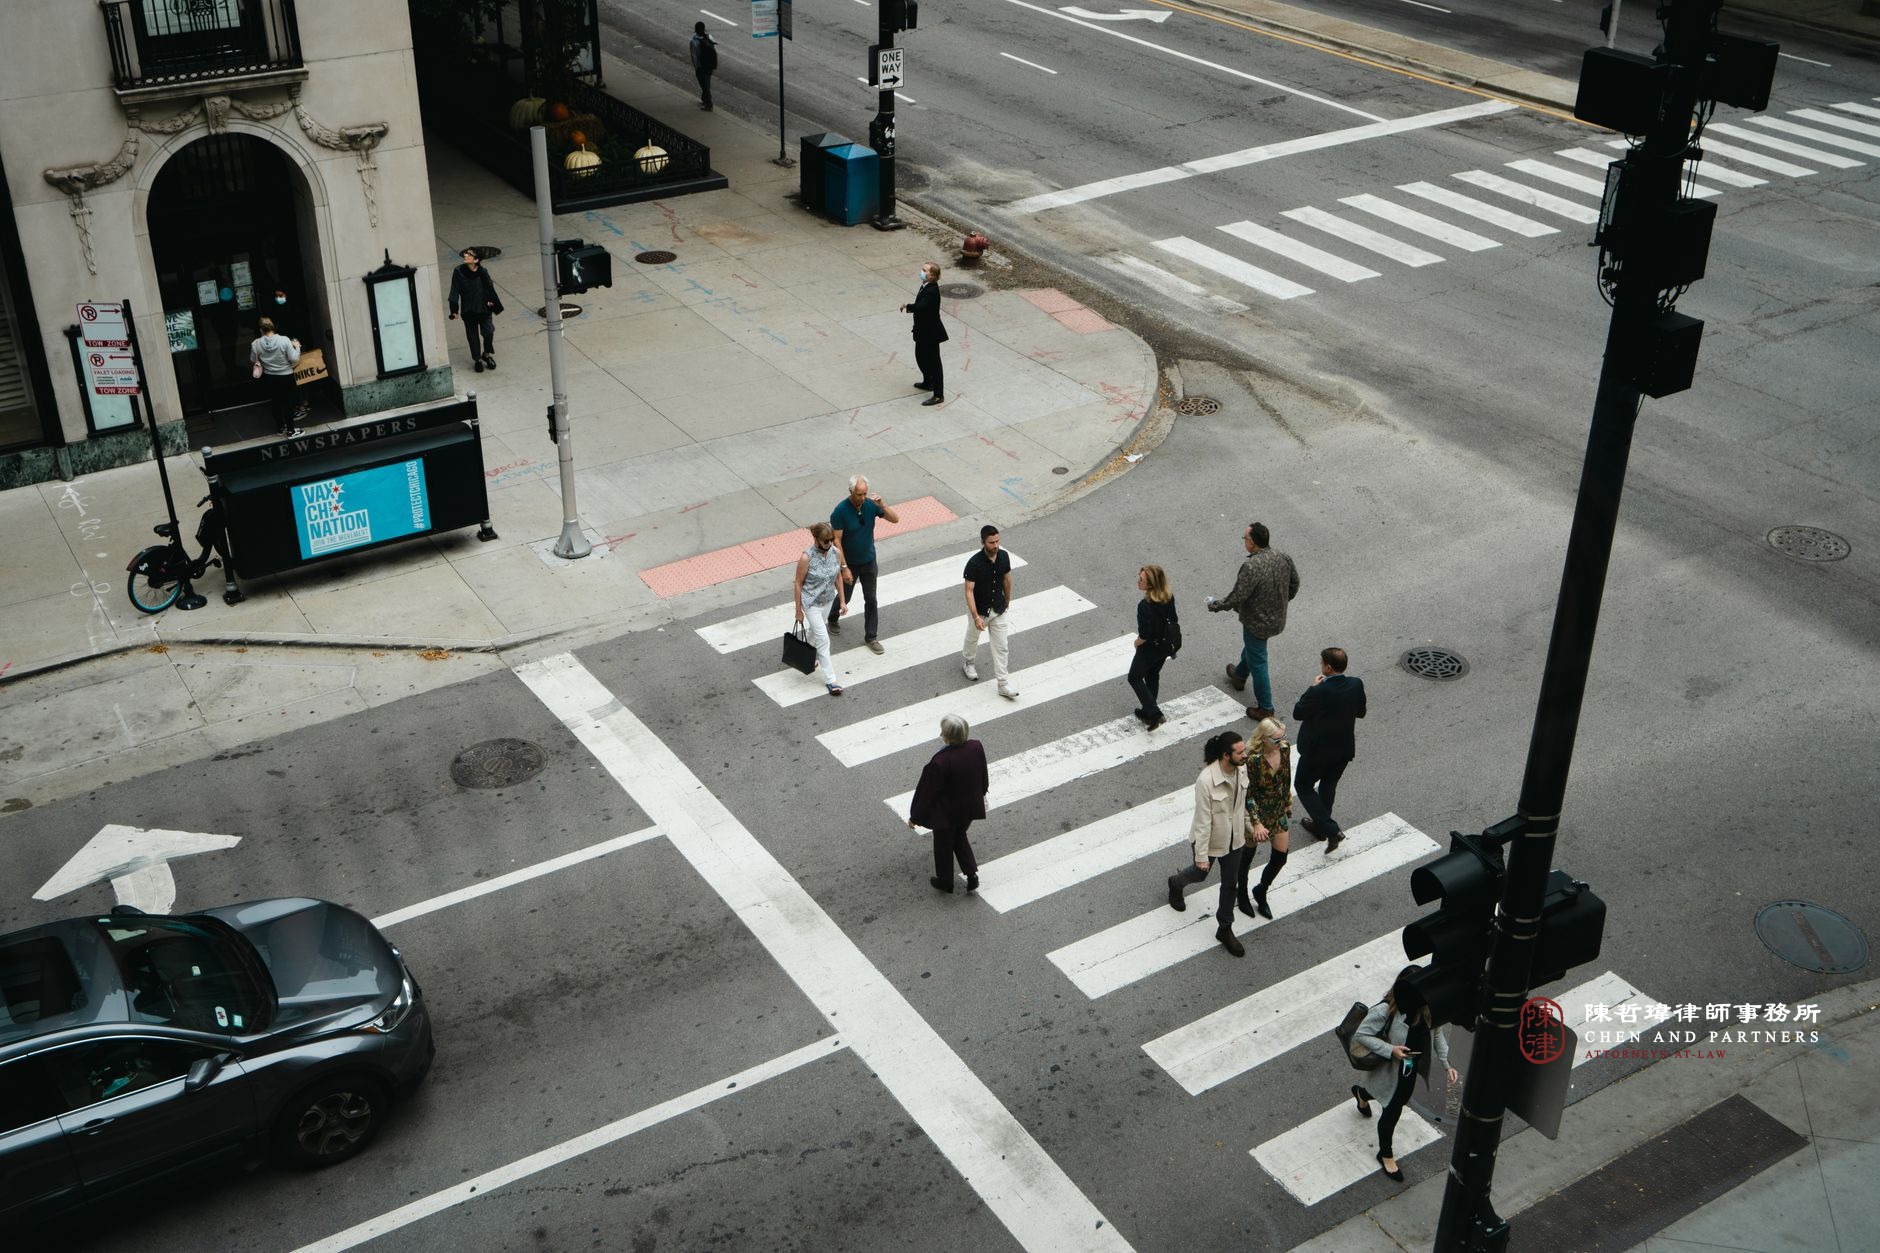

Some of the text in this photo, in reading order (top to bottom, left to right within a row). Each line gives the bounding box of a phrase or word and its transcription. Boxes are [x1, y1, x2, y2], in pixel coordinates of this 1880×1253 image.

[882, 51, 901, 63] ONE
[881, 63, 901, 74] WAY
[166, 315, 177, 323] VE
[166, 324, 177, 332] HE
[295, 367, 315, 381] NIKE
[260, 417, 417, 461] NEWSPAPERS
[304, 482, 336, 505] VAX
[406, 461, 425, 529] #PROTECTCHICAGO
[309, 511, 368, 540] NATION
